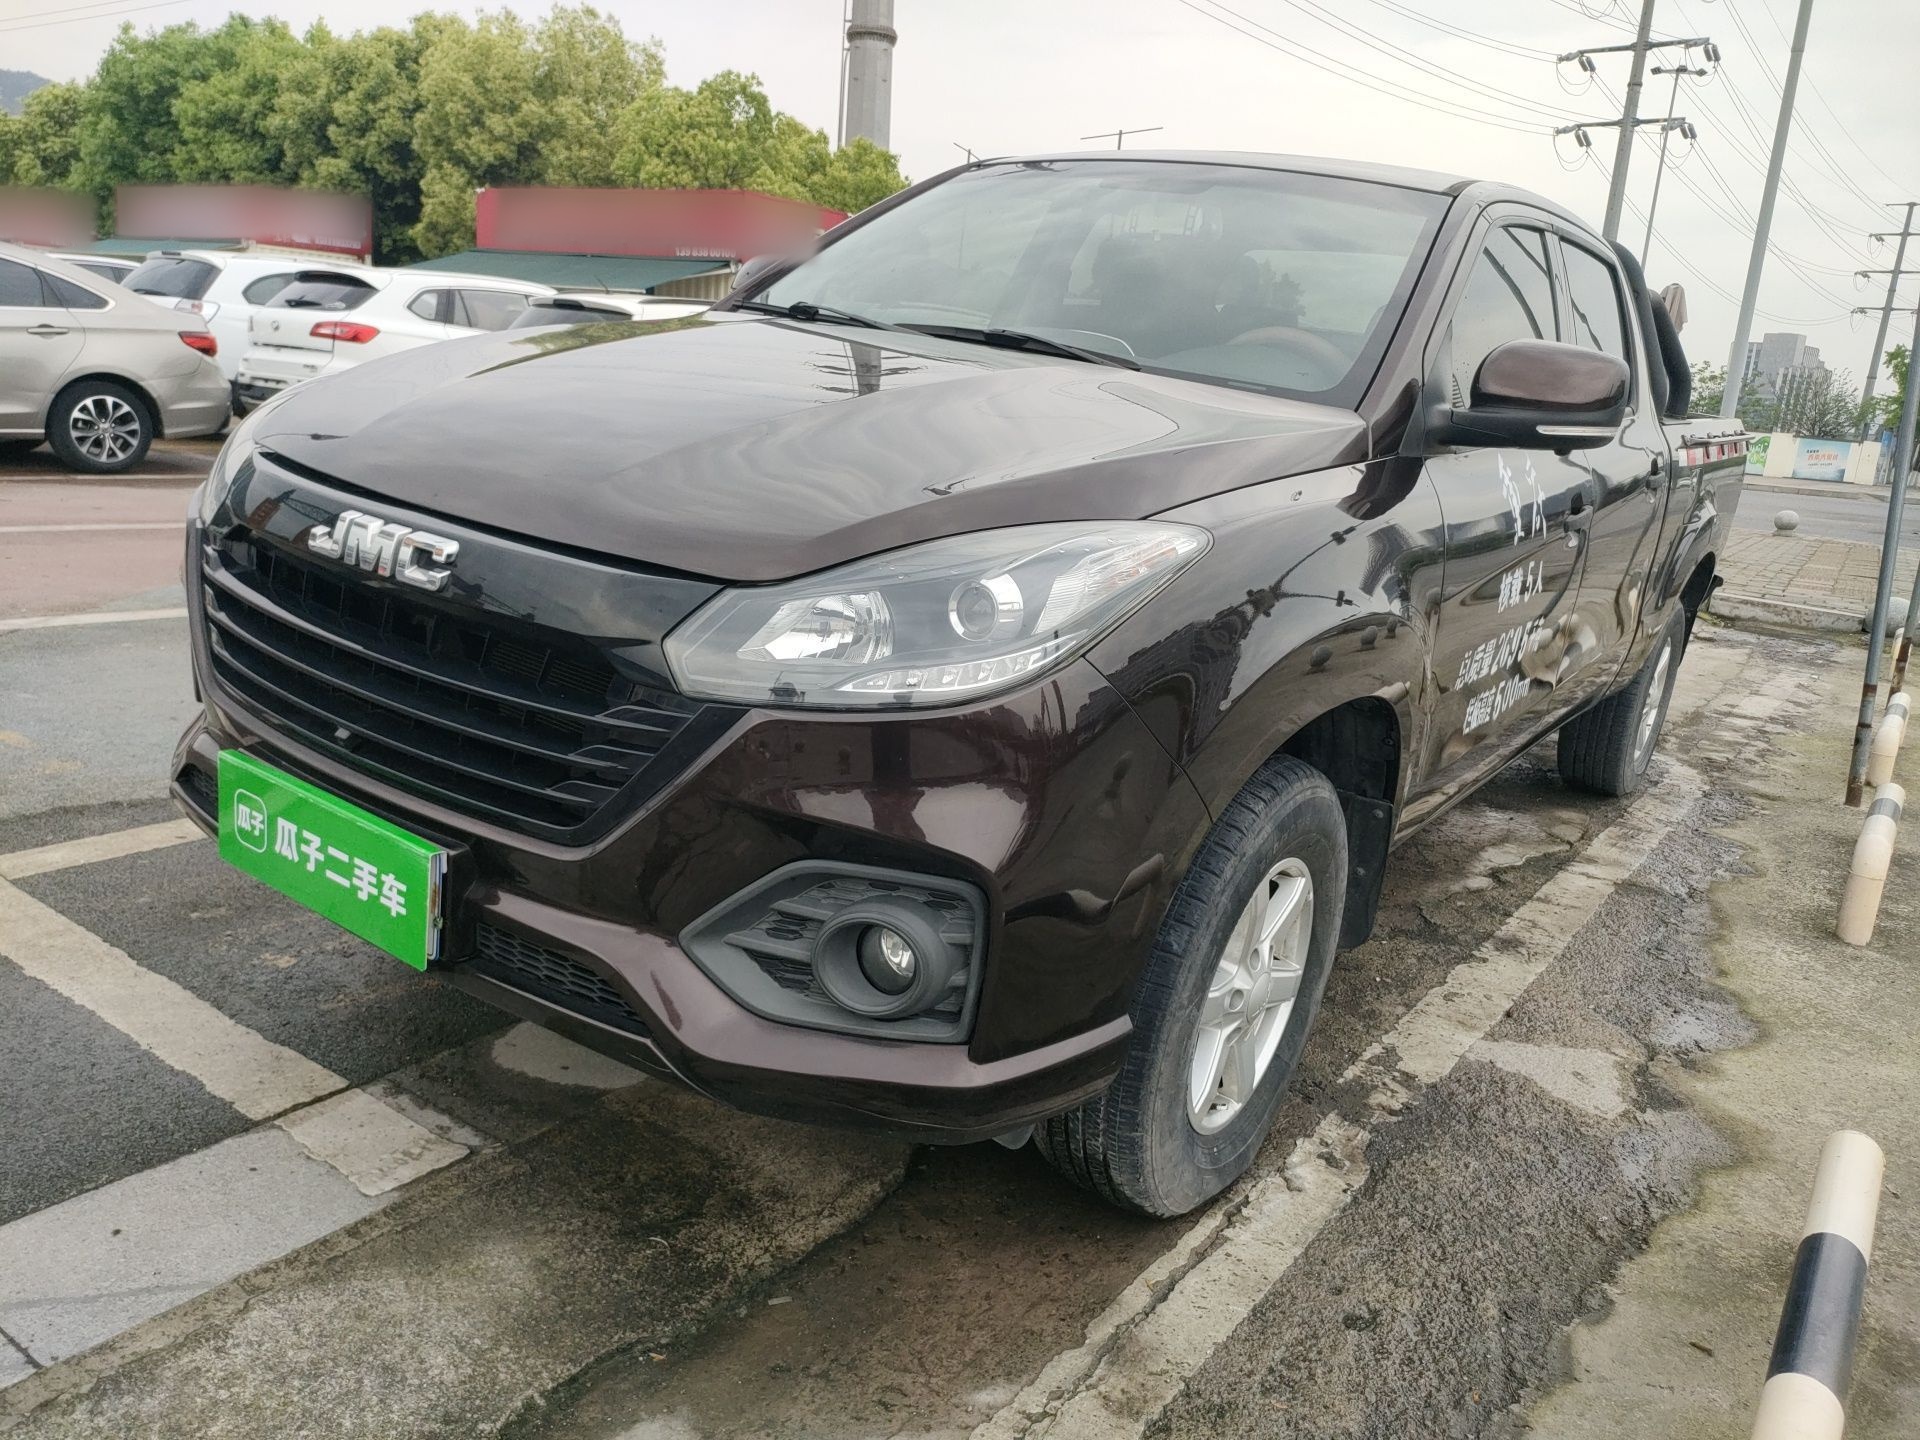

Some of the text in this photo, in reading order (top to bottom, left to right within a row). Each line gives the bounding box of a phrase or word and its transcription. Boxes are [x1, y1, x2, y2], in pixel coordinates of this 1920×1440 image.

[308, 510, 459, 591] JMC
[237, 804, 265, 836] 瓜子
[275, 816, 407, 917] 瓜子二手车
